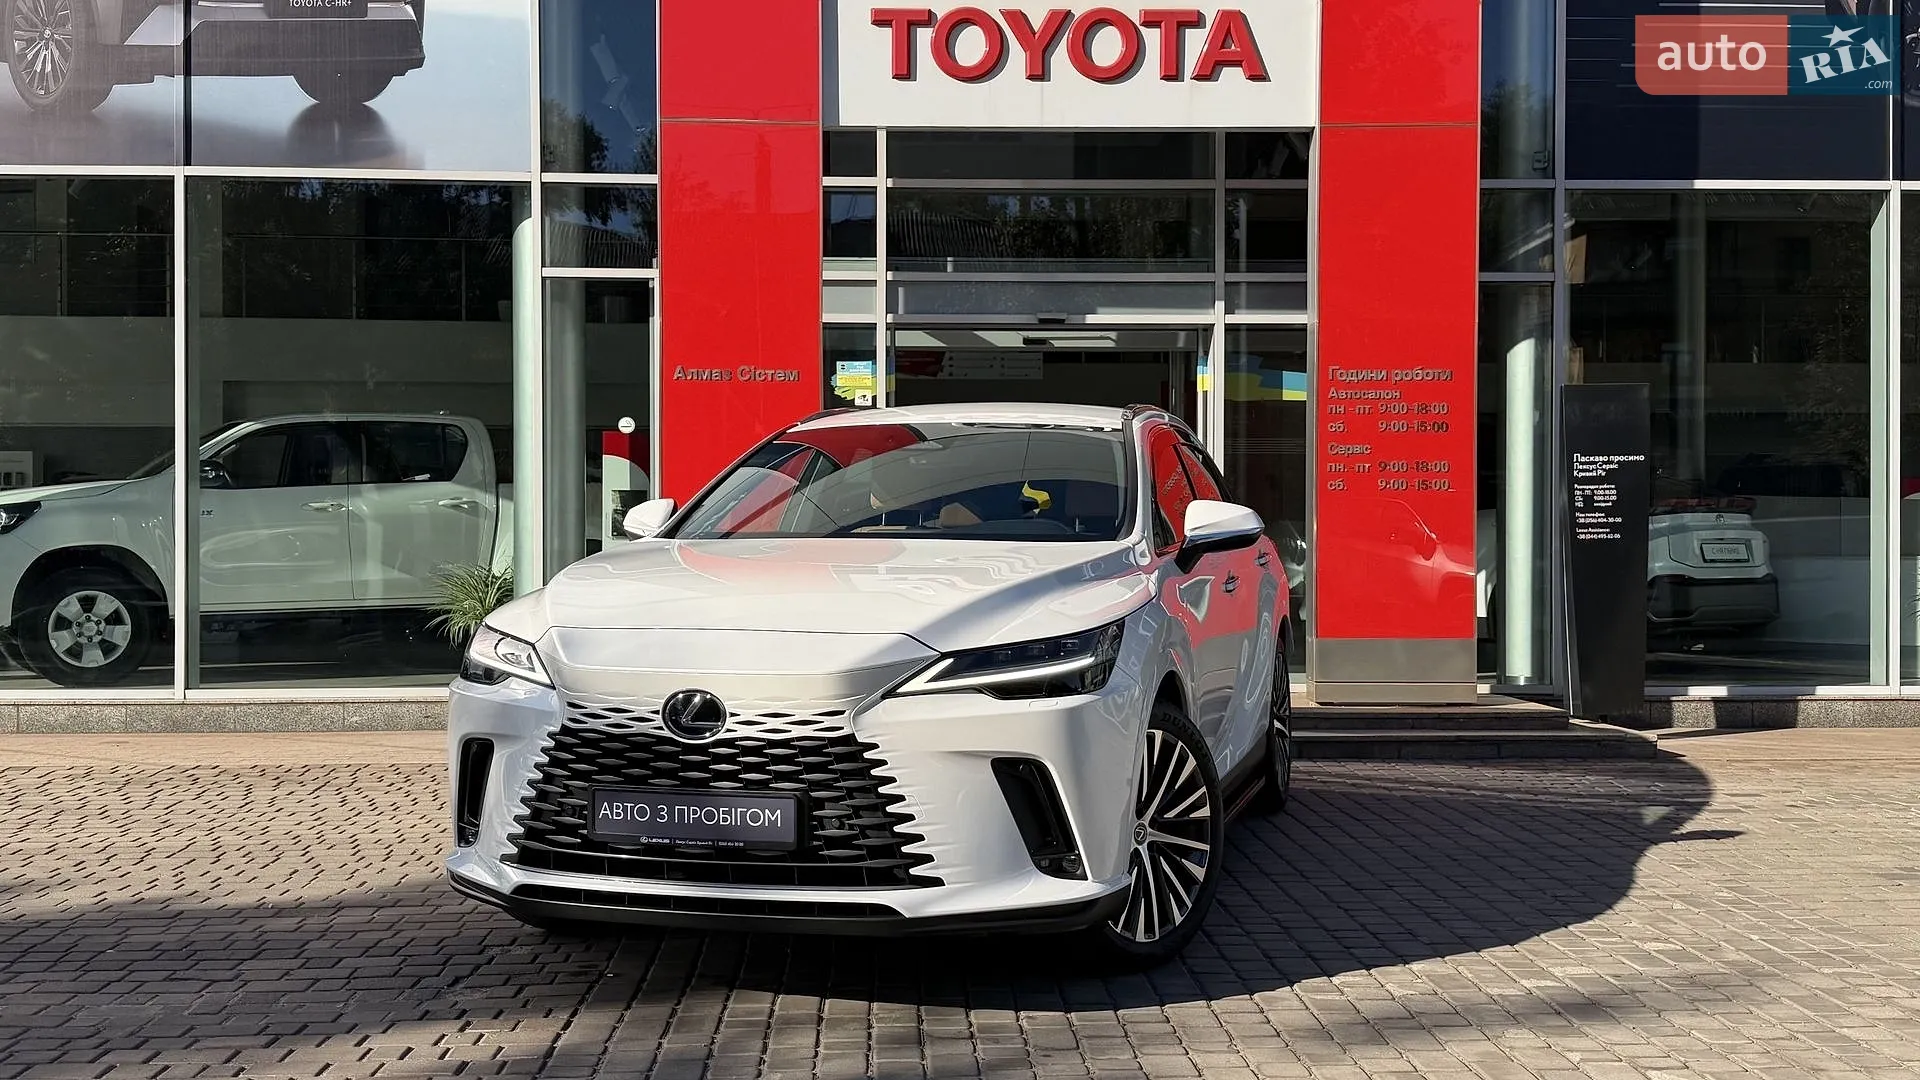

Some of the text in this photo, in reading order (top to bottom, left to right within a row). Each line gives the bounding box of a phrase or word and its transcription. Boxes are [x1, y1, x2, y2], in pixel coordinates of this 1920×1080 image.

[871, 7, 1267, 81] TOYOTA
[673, 365, 800, 381] Алмаз Сістем
[1328, 365, 1453, 384] Години роботи
[1328, 387, 1402, 399] Автосалон
[1328, 442, 1372, 457] Сервіс
[599, 802, 781, 827] АВТО З ПРОБІГОМ
